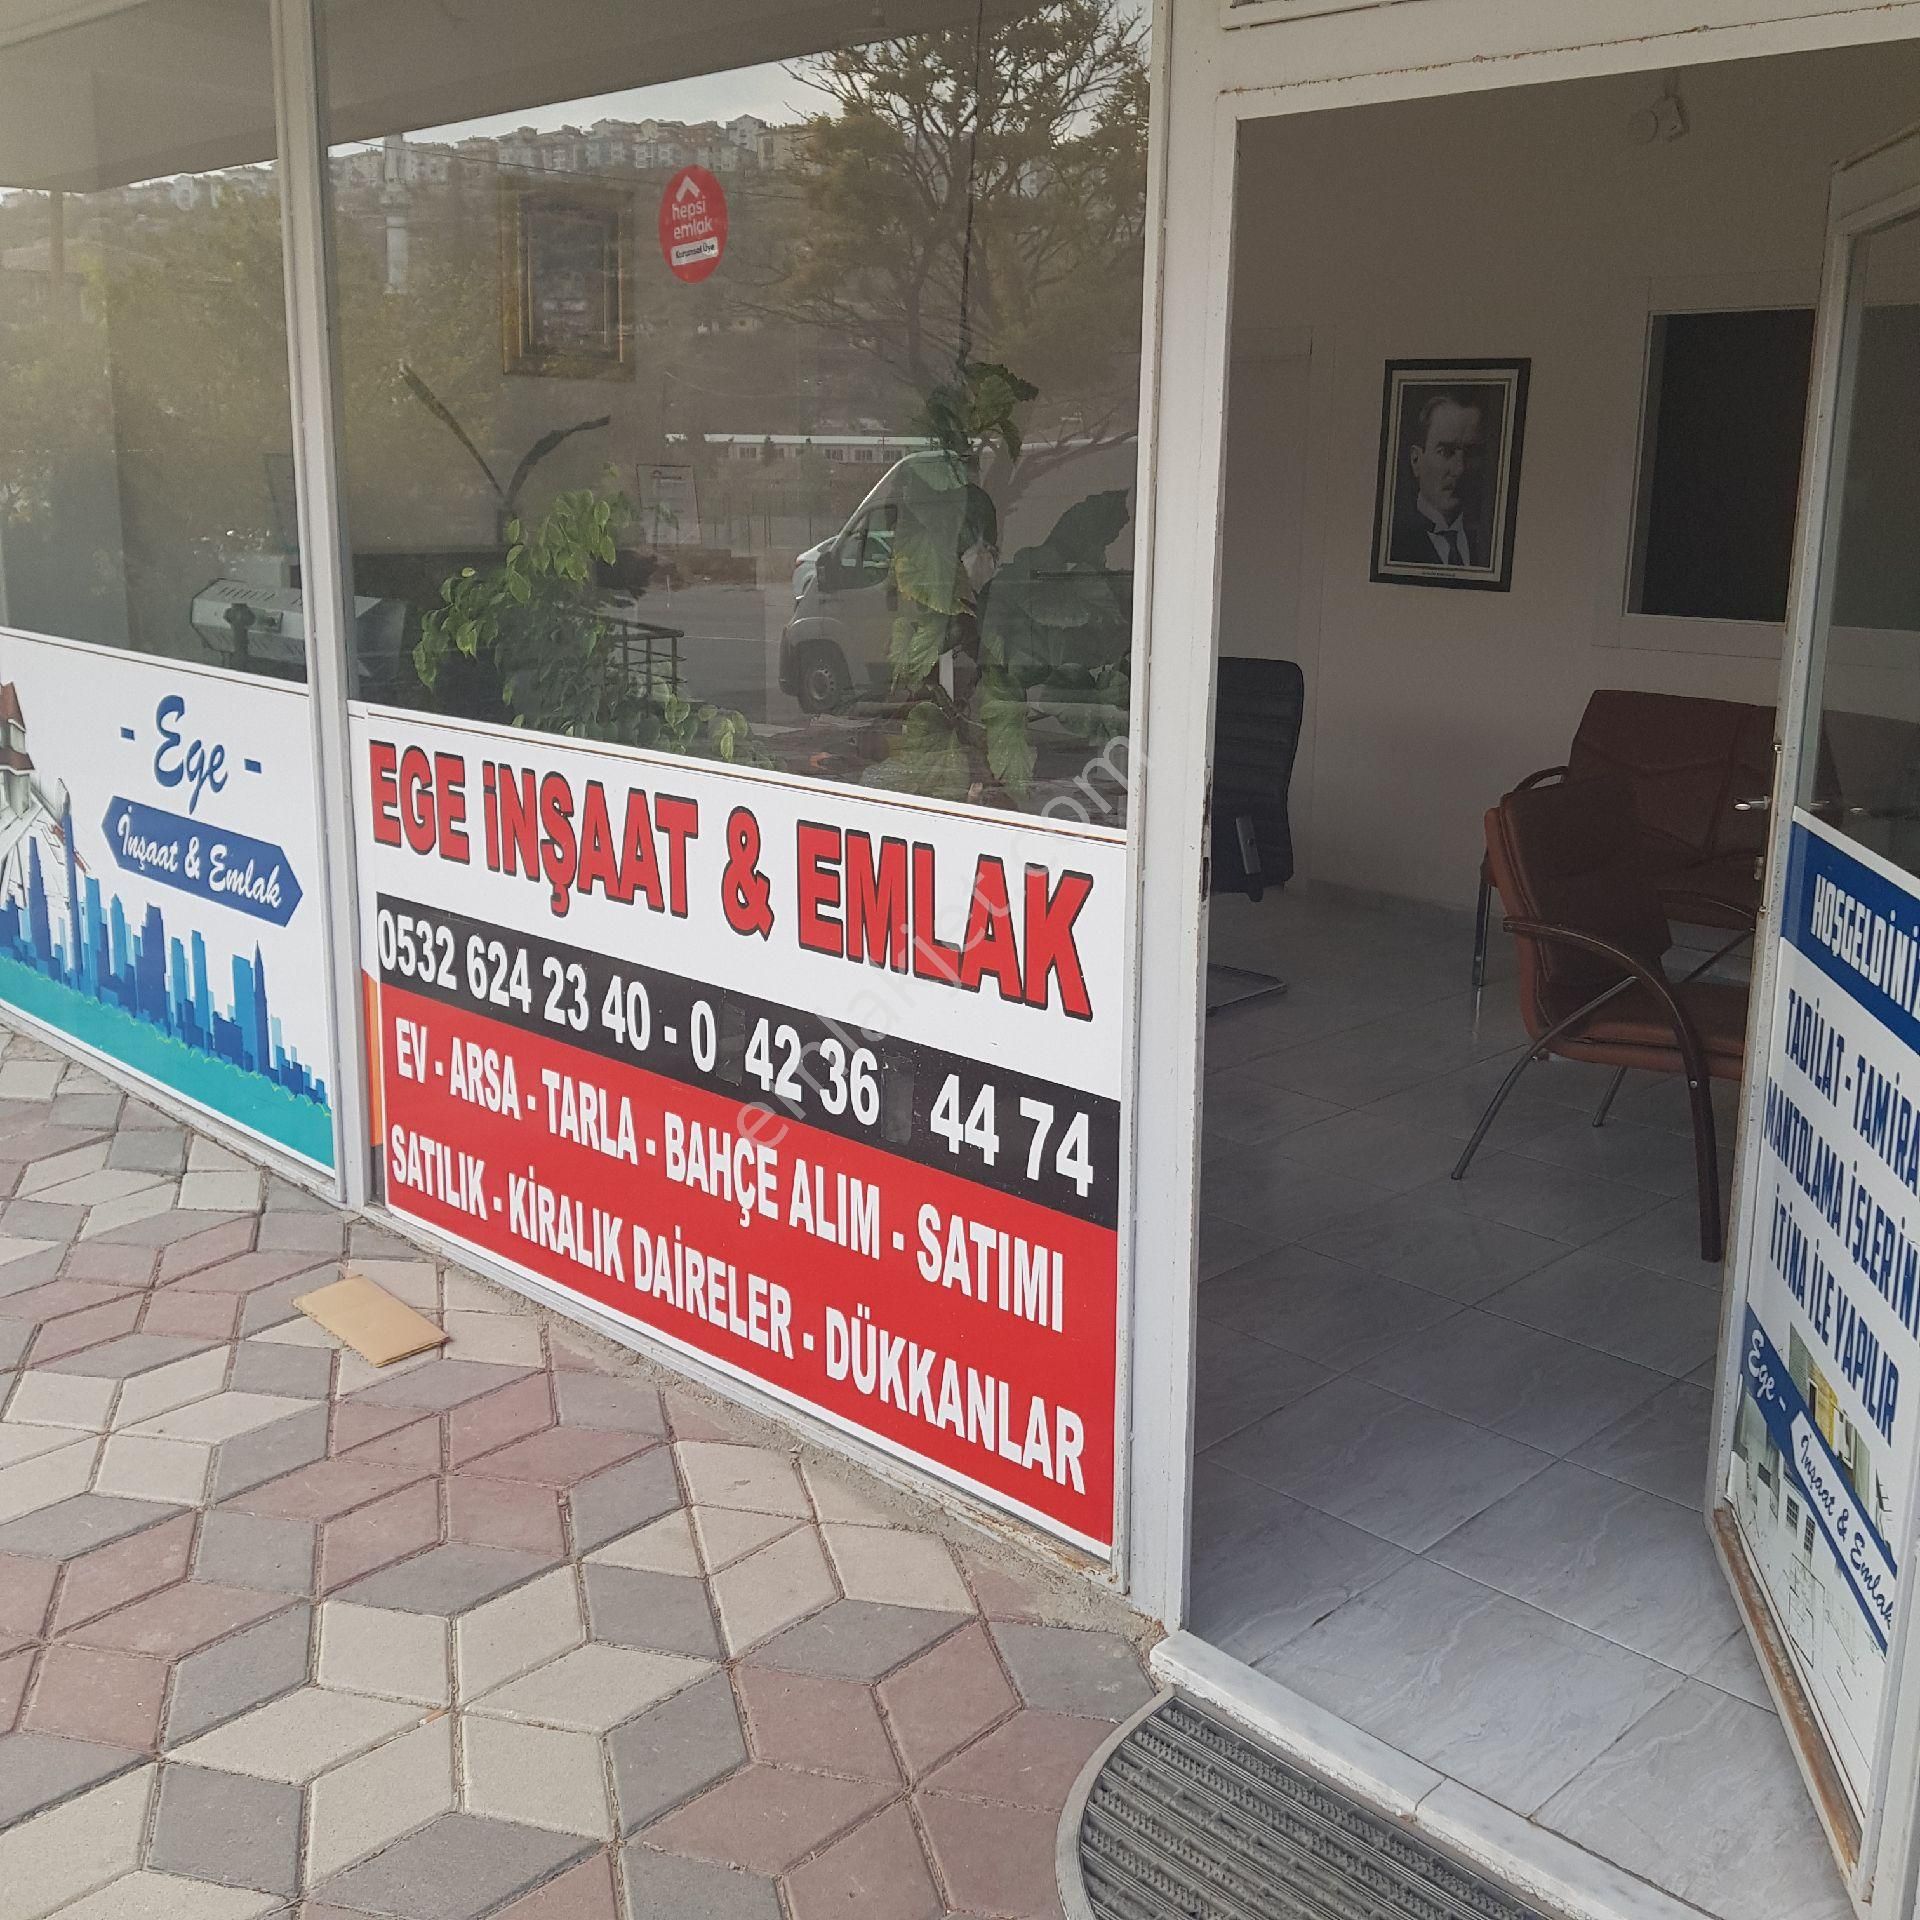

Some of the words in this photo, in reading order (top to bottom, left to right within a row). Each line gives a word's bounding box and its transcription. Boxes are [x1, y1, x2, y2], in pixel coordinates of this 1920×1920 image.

[672, 195, 706, 220] hepsi
[673, 215, 712, 239] emlak
[118, 805, 178, 872] İnşaat
[184, 836, 200, 880] &
[209, 843, 281, 909] Emlak
[154, 694, 227, 815] Ege
[369, 739, 470, 865] EGE
[482, 760, 698, 919] İNŞAAT
[721, 806, 774, 941] &
[797, 819, 1093, 1022] EMLAK
[378, 908, 457, 990] 0532
[466, 933, 532, 1014] 624
[543, 956, 589, 1032] 23
[601, 975, 650, 1051] 40
[690, 1000, 717, 1072] 0
[745, 1017, 802, 1102] 42
[819, 1038, 880, 1125] 36
[930, 1073, 999, 1166] 44
[1020, 1097, 1094, 1197] 74
[1764, 1076, 1844, 1238] MANTOLAMA
[1786, 988, 1844, 1107] TADİLAT
[1853, 1054, 1920, 1203] TAMİRA
[396, 1017, 427, 1084] EV
[450, 1036, 522, 1120] ARSA
[542, 1068, 638, 1165] TARLA
[664, 1111, 779, 1228] BAHÇE
[789, 1158, 880, 1260] ALIM
[916, 1203, 1063, 1333] SATIMI
[391, 1124, 488, 1220] SATILIK
[508, 1165, 625, 1283] KİRALIK
[633, 1224, 794, 1359] DAİRELER
[826, 1303, 1086, 1495] DÜKKANLAR
[1770, 1182, 1808, 1311] İTİNA
[1808, 1238, 1834, 1346] İLE
[1834, 1285, 1899, 1448] YAPILIR
[1748, 1331, 1774, 1400] Ege
[1800, 1434, 1835, 1517] İnşaat
[1837, 1508, 1849, 1542] &
[1850, 1532, 1894, 1631] Emlak
